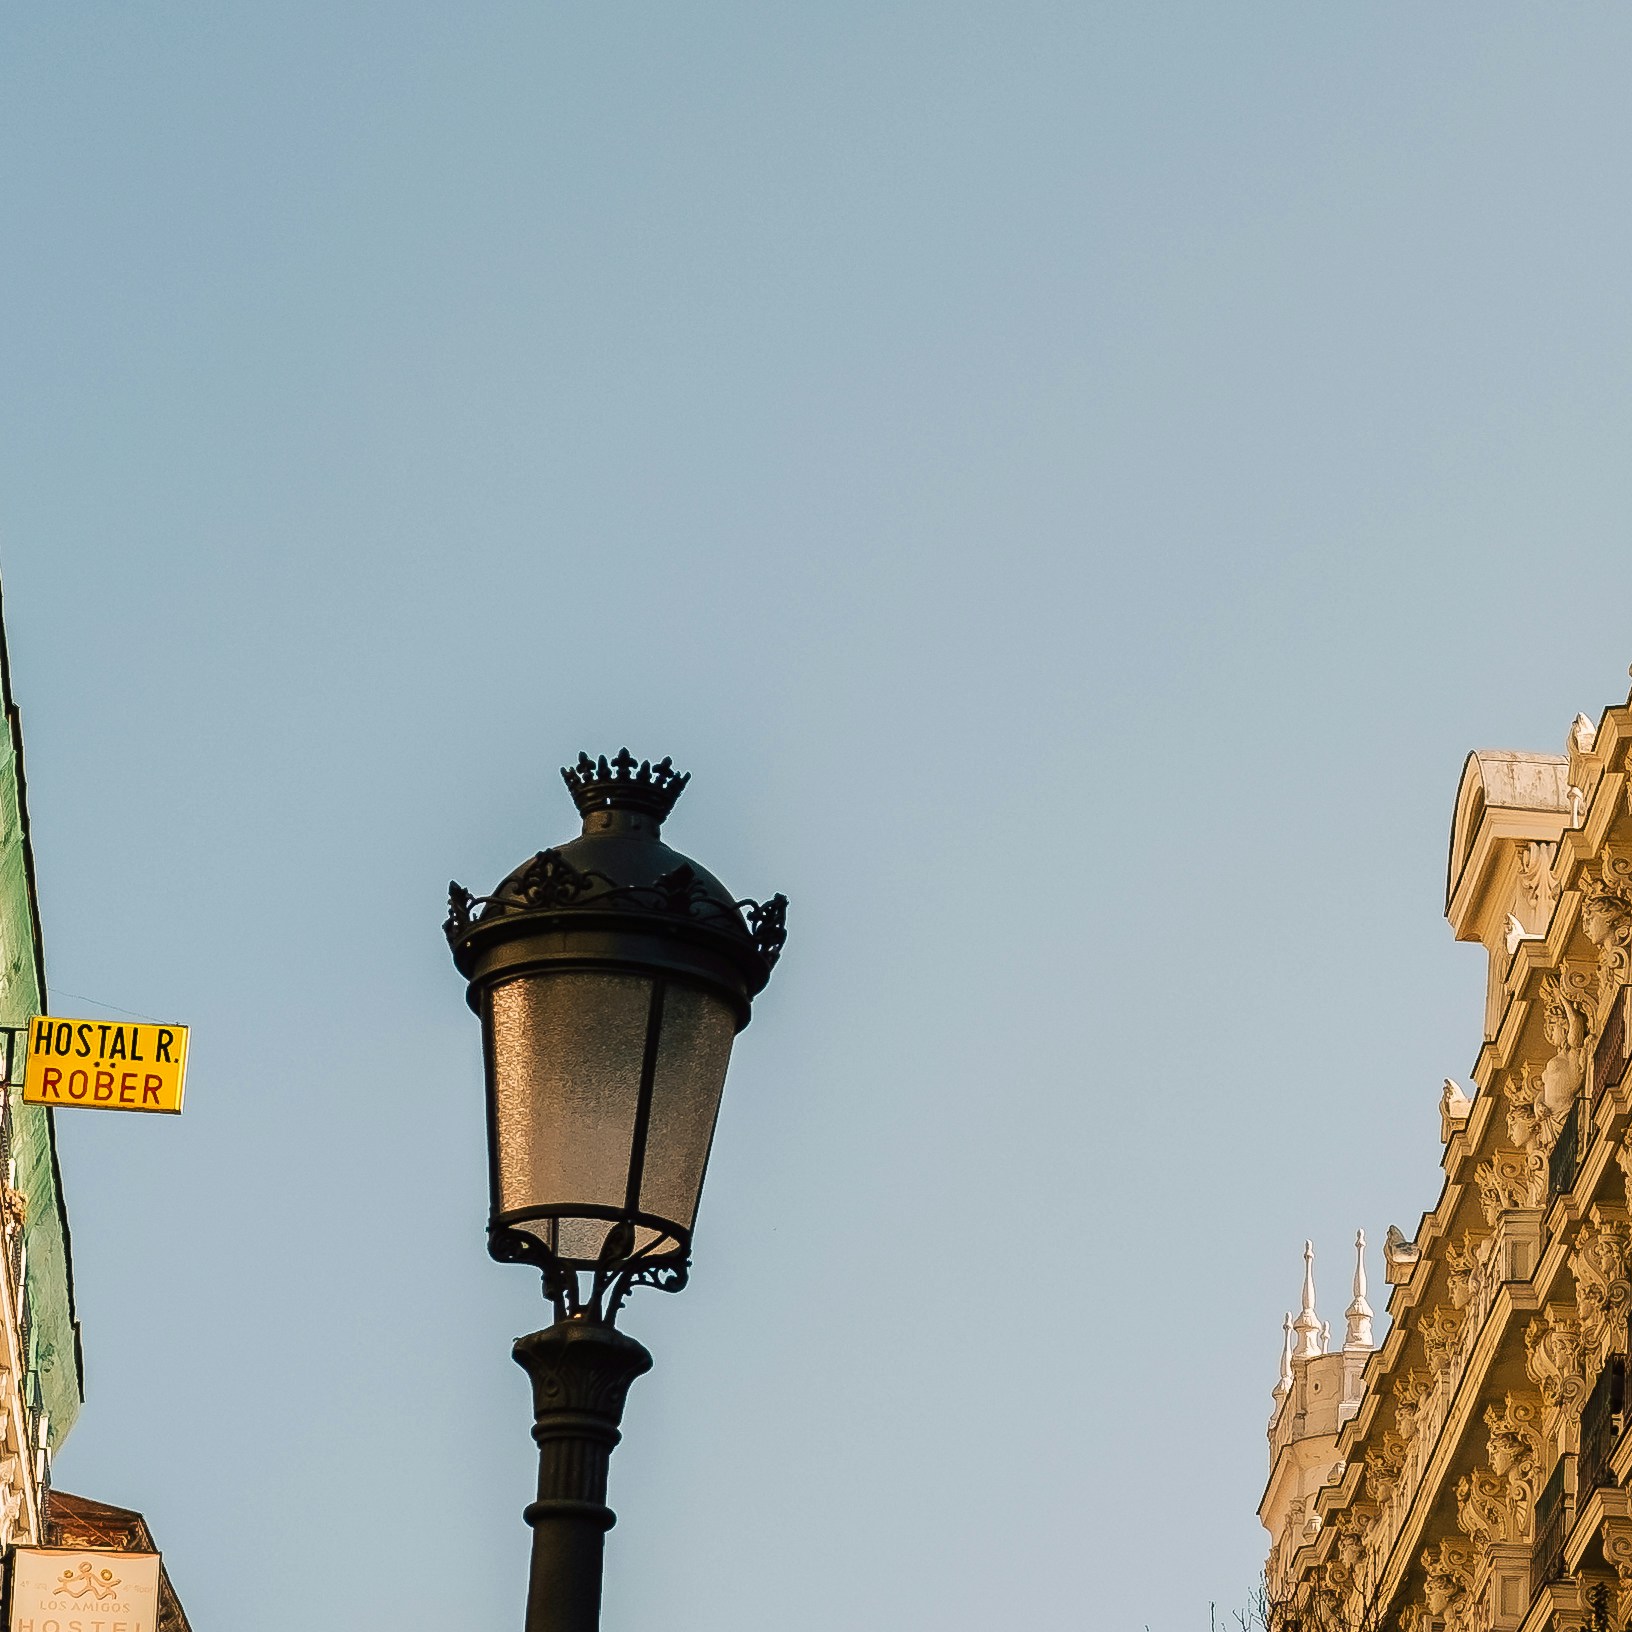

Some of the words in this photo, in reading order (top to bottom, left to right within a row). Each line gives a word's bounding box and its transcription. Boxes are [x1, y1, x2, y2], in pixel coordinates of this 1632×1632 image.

[34, 1021, 143, 1061] HOSTAL
[156, 1028, 179, 1063] R.
[41, 1067, 163, 1105] ROBER
[40, 1600, 67, 1611] LOS
[71, 1600, 131, 1614] AMIGOS
